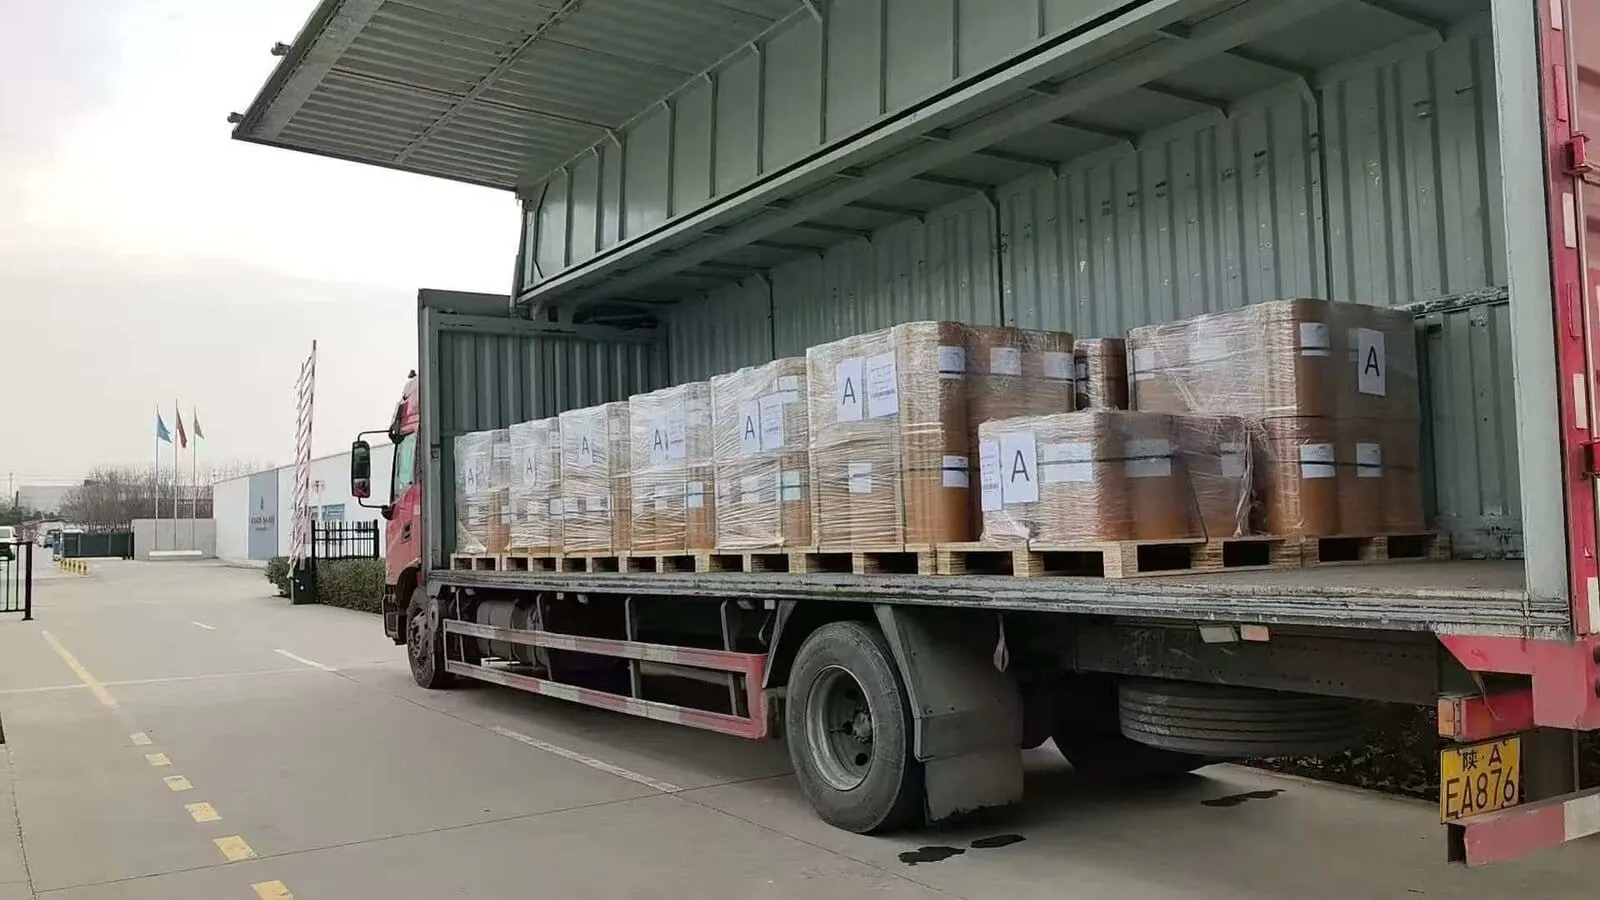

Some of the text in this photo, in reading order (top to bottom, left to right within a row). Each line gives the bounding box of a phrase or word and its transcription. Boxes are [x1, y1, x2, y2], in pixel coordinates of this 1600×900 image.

[1364, 346, 1380, 376] A
[842, 376, 856, 405] A
[653, 428, 663, 451] A
[744, 415, 756, 440] A
[581, 436, 590, 455] A
[467, 467, 474, 484] A
[525, 456, 533, 474] A
[1011, 449, 1030, 483] A
[1446, 766, 1515, 818] EA876
